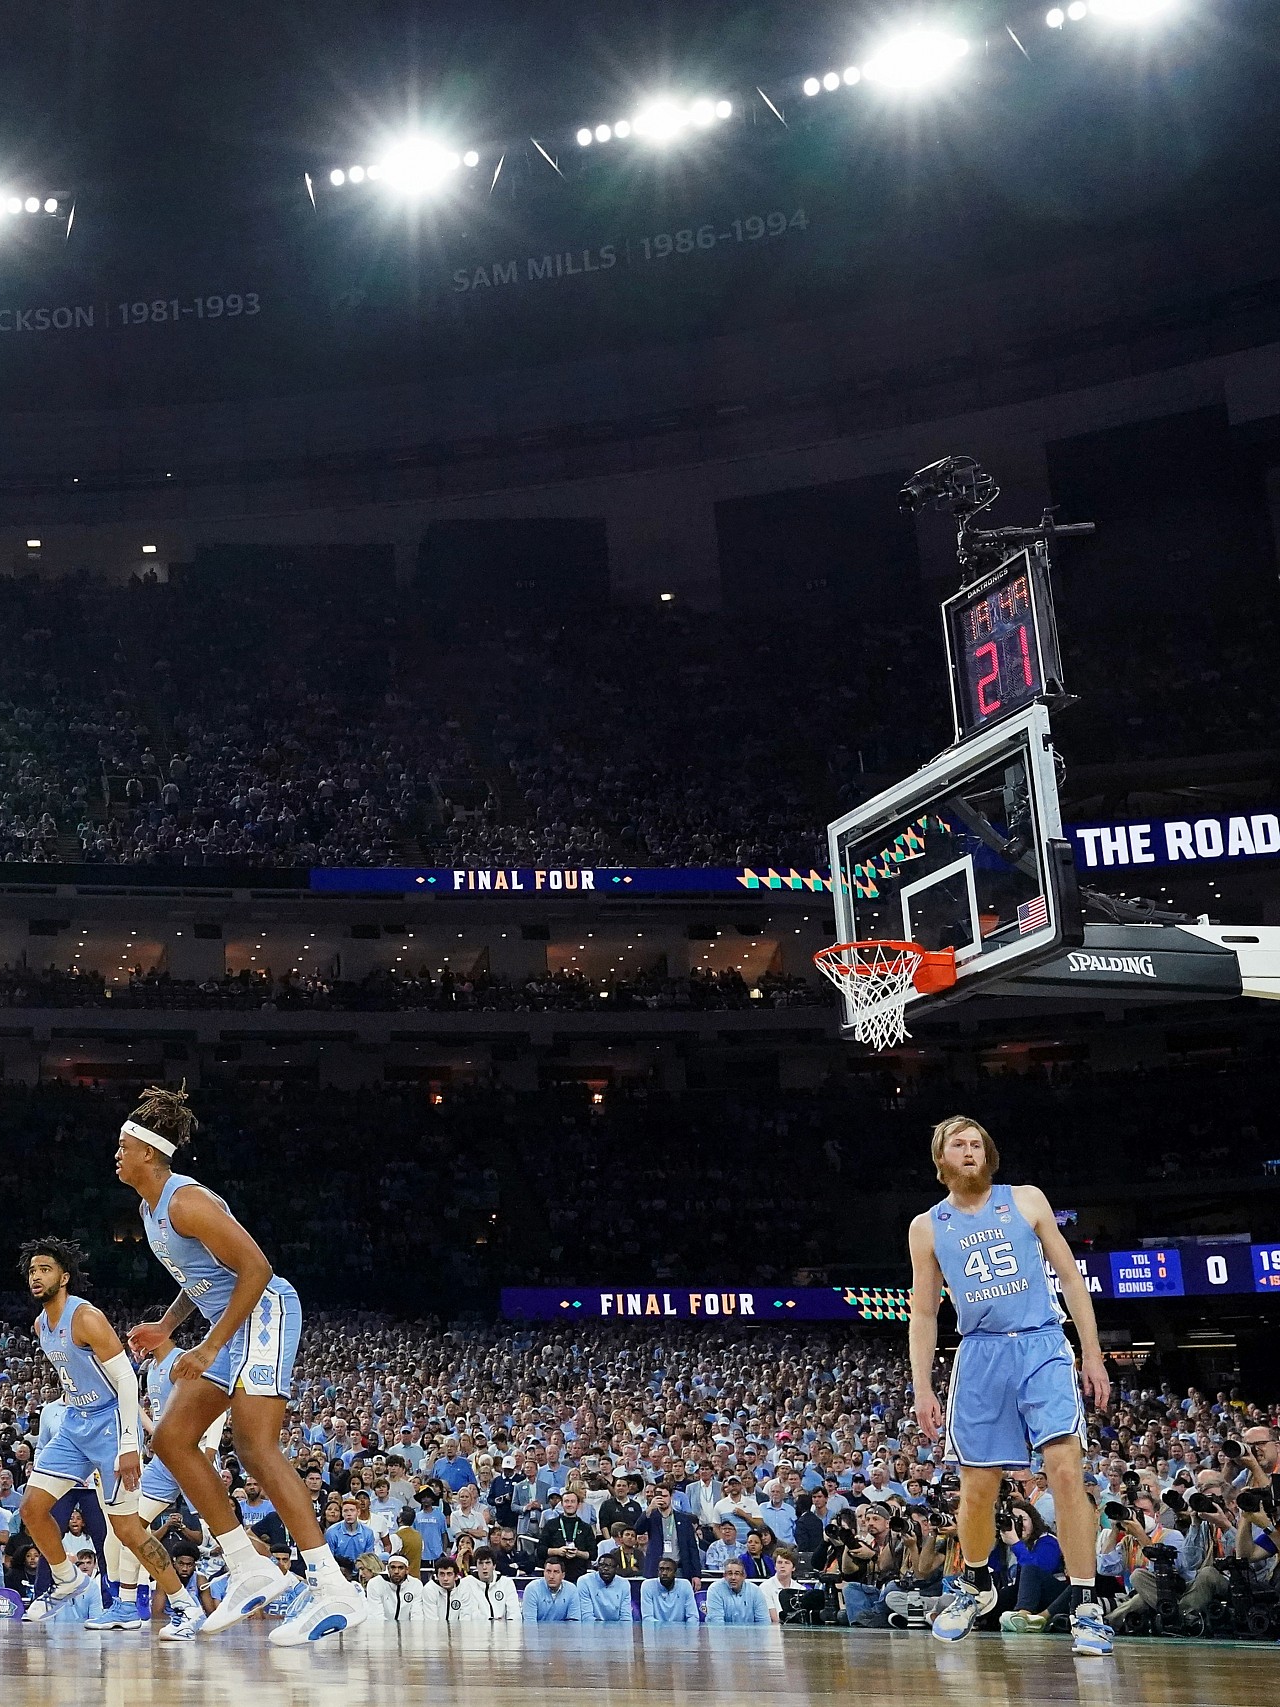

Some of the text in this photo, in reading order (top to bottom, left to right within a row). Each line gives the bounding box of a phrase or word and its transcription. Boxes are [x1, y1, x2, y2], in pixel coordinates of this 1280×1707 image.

[453, 208, 810, 293] SAM MILLS 1986-1994
[119, 292, 262, 325] 1981-1993
[967, 568, 1009, 599] DAKTRONICS
[975, 624, 1034, 716] 21
[1076, 813, 1280, 867] THE ROAD
[453, 870, 596, 890] FINAL FOUR
[1067, 952, 1157, 978] SPALDING
[959, 1228, 1005, 1250] NORTH
[160, 1256, 188, 1283] 5
[963, 1241, 1020, 1284] 45
[1156, 1252, 1166, 1264] 4
[1206, 1255, 1229, 1285] 0
[1119, 1266, 1167, 1279] FOULS 0
[965, 1277, 1030, 1304] CAROLINA
[1118, 1281, 1154, 1293] BONUS
[601, 1293, 756, 1315] FINAL FOUR
[59, 1366, 78, 1393] 4
